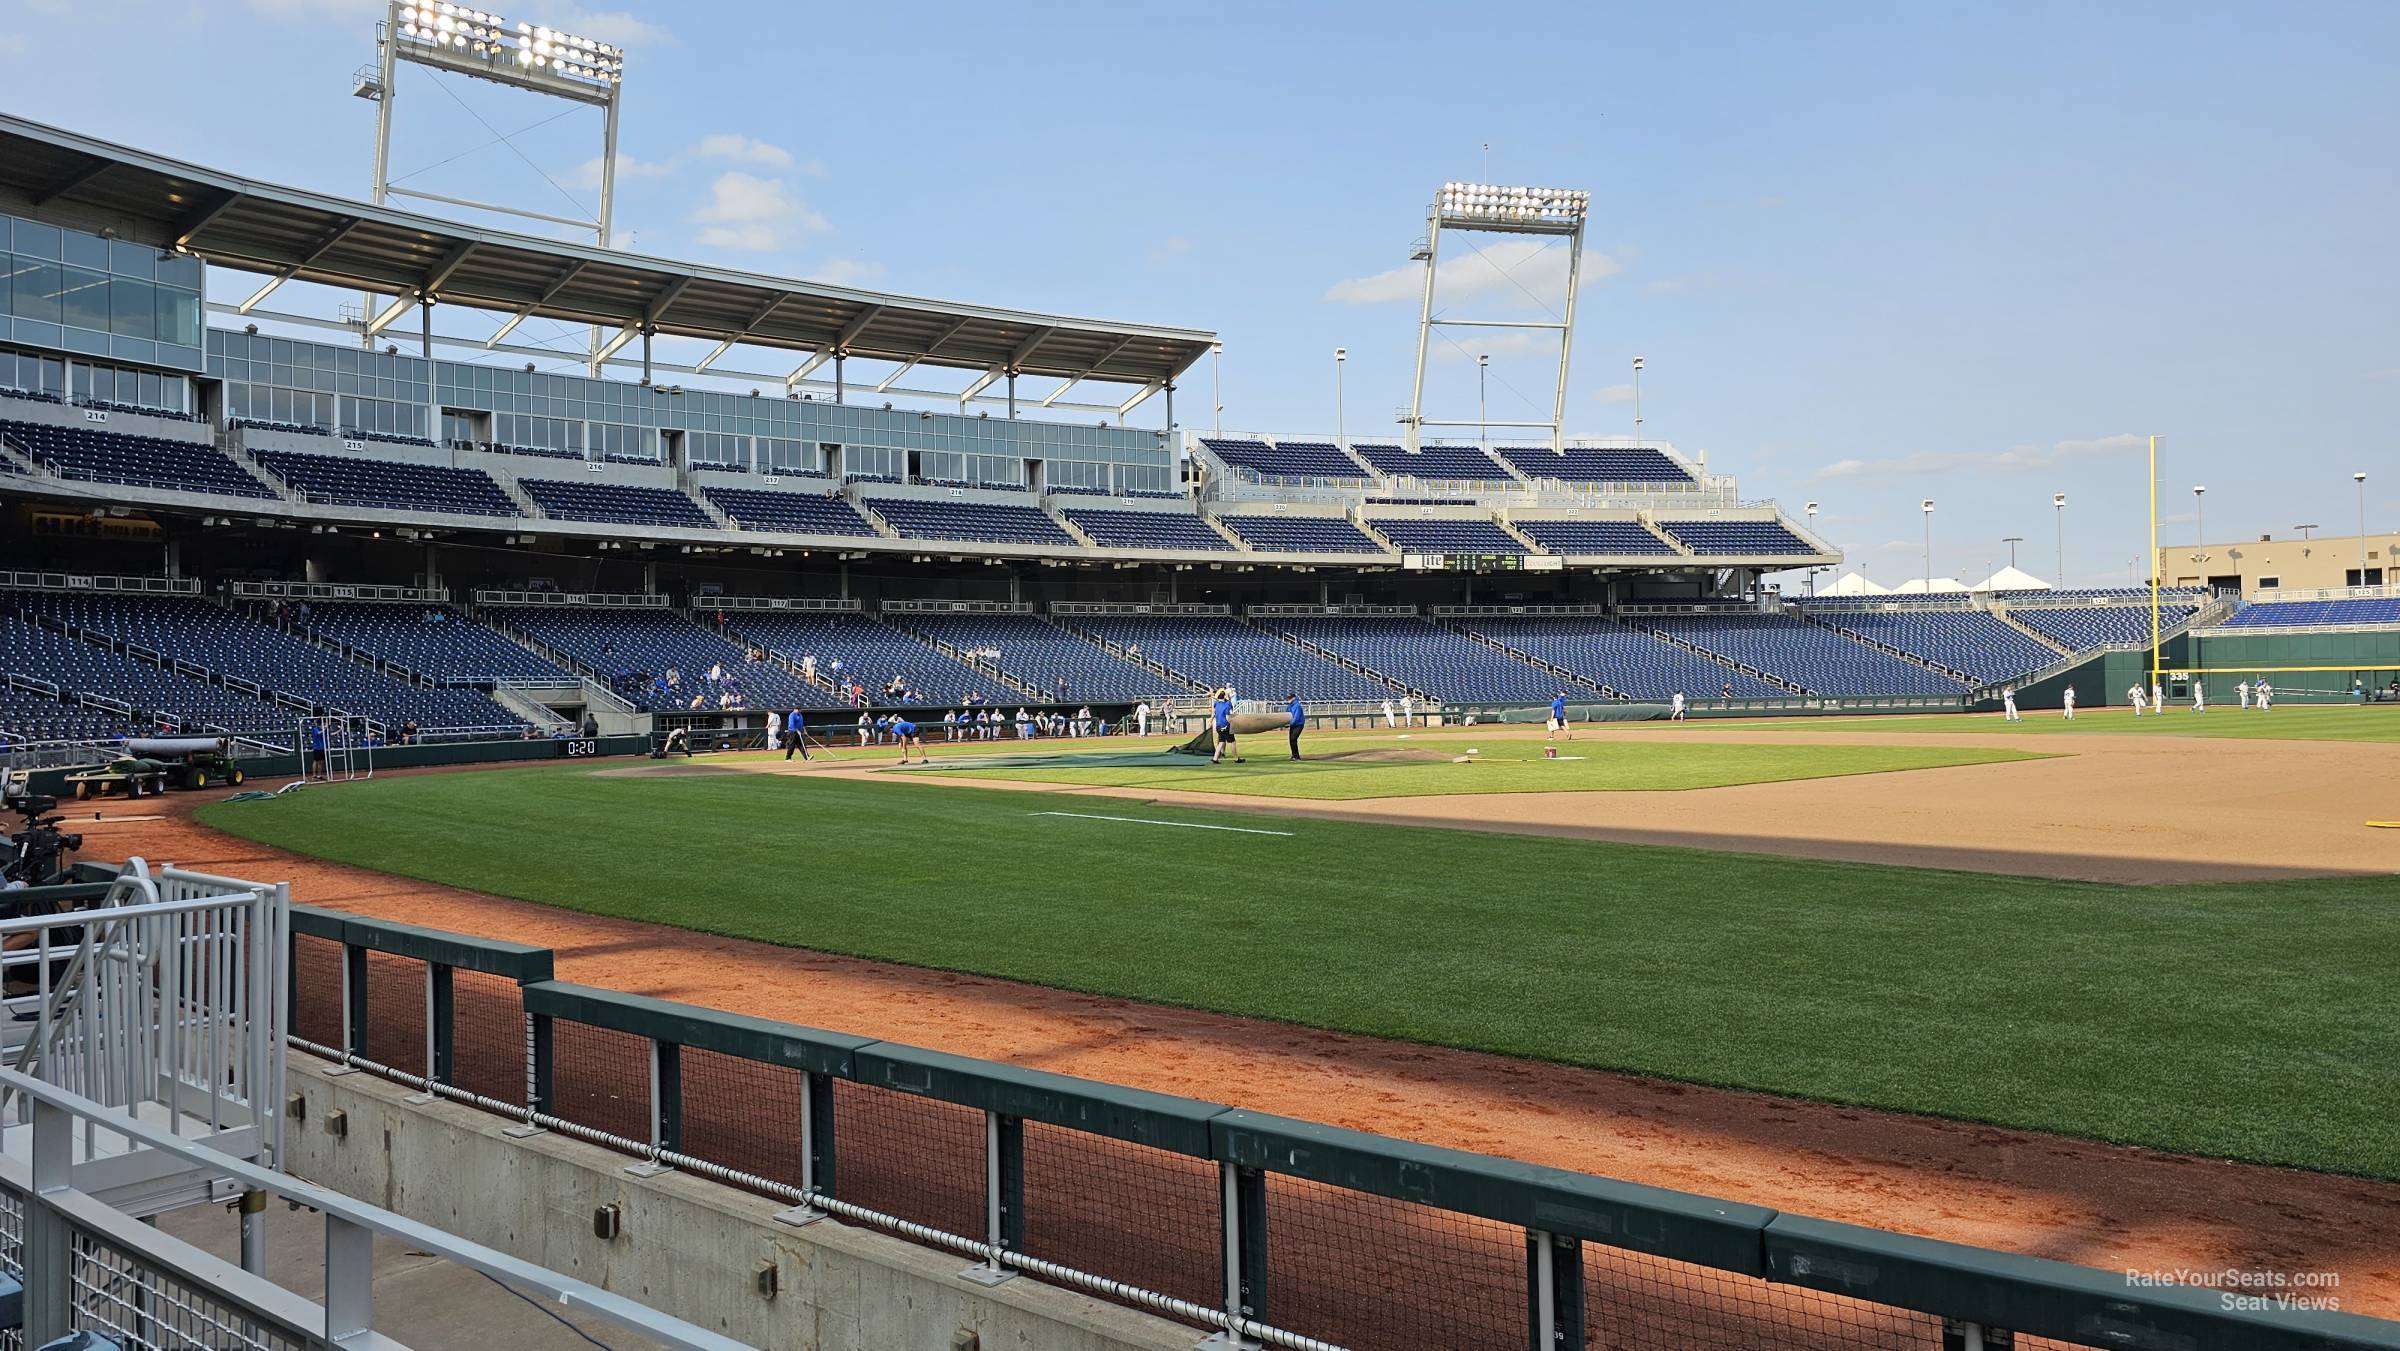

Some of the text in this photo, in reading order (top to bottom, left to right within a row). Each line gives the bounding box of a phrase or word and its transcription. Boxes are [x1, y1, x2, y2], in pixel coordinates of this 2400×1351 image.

[87, 411, 106, 421] 214
[346, 441, 362, 449] 215
[71, 578, 89, 586] 114
[337, 588, 352, 596] 115
[2169, 672, 2189, 681] 335
[568, 741, 595, 754] 0:20
